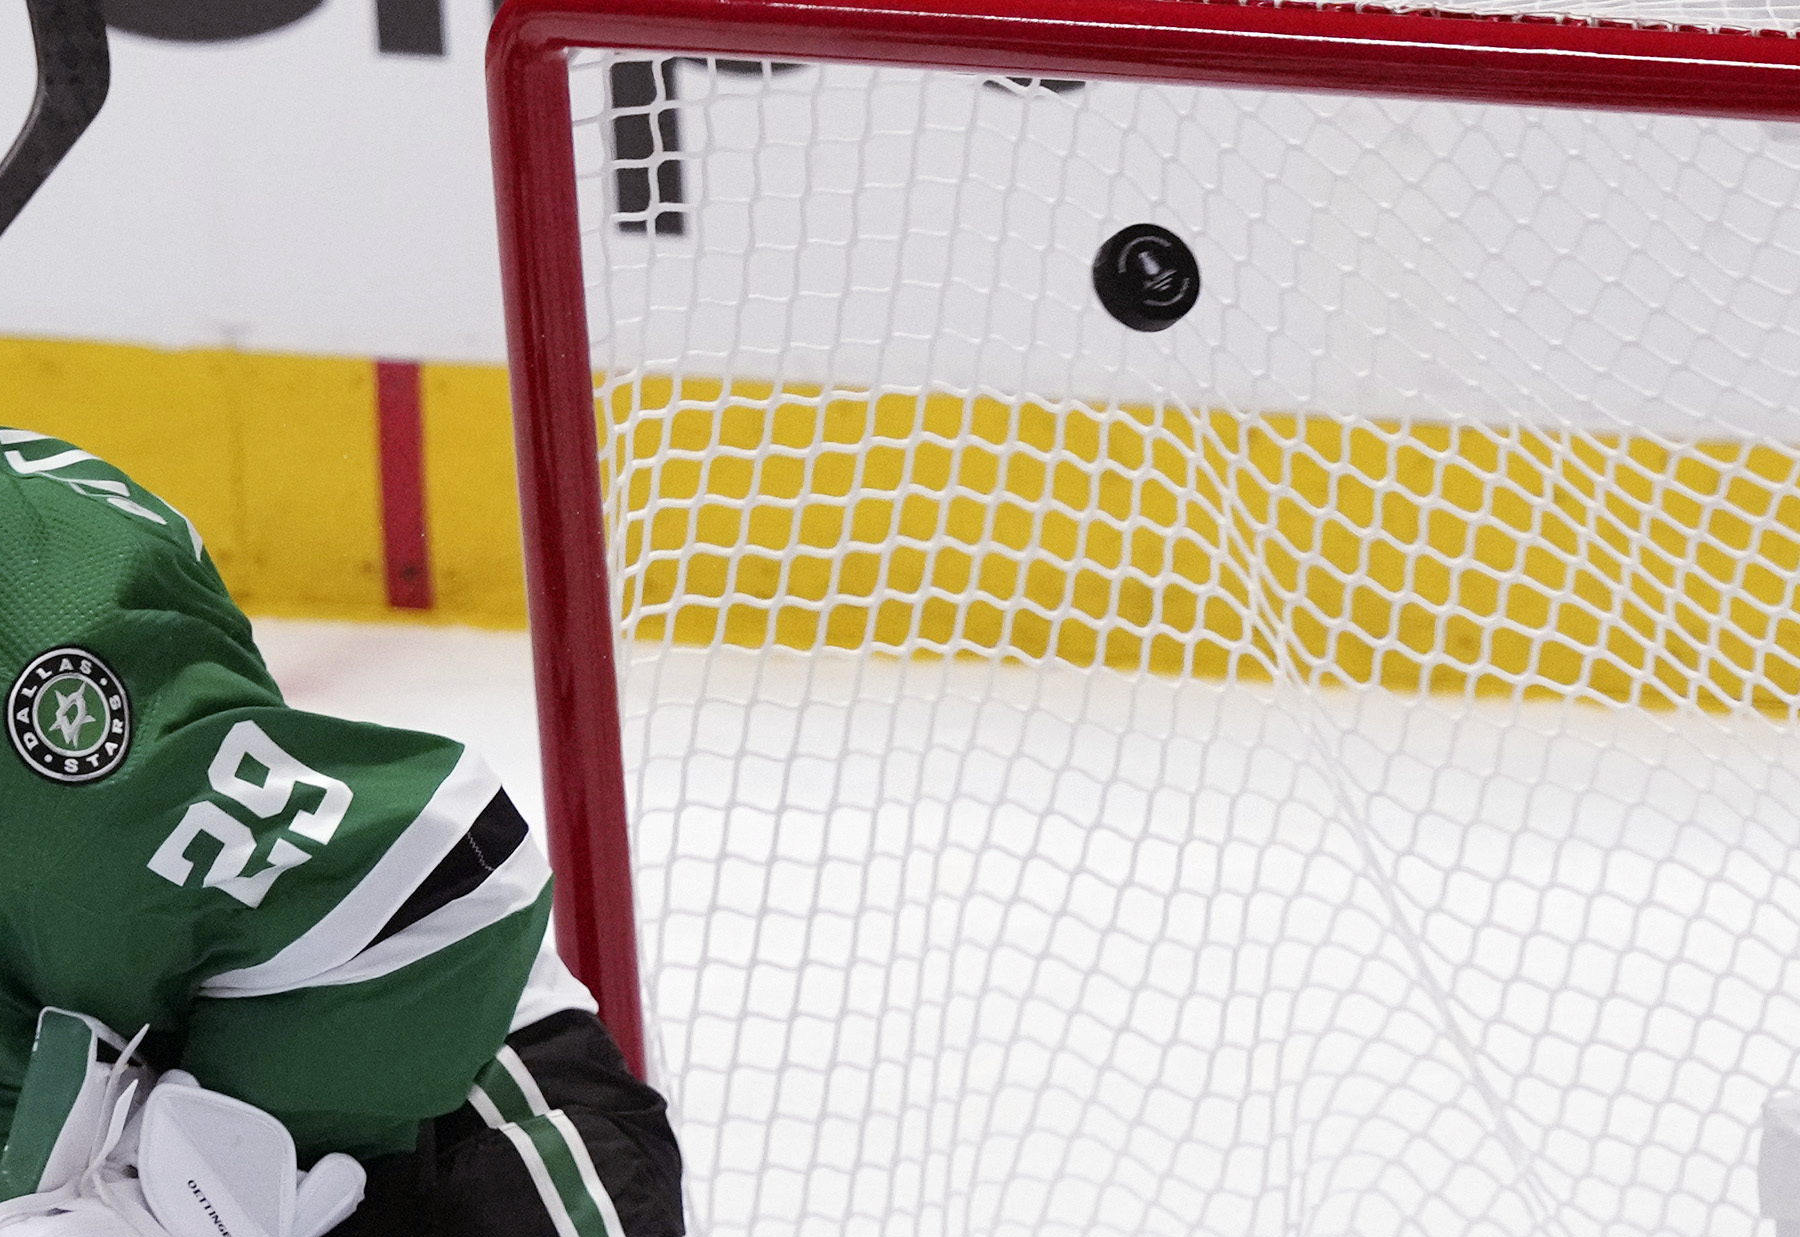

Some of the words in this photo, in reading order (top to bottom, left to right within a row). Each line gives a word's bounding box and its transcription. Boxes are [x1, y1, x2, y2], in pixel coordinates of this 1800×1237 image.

[16, 658, 94, 751] DALLAS
[63, 694, 124, 774] STARS
[146, 720, 355, 909] 29
